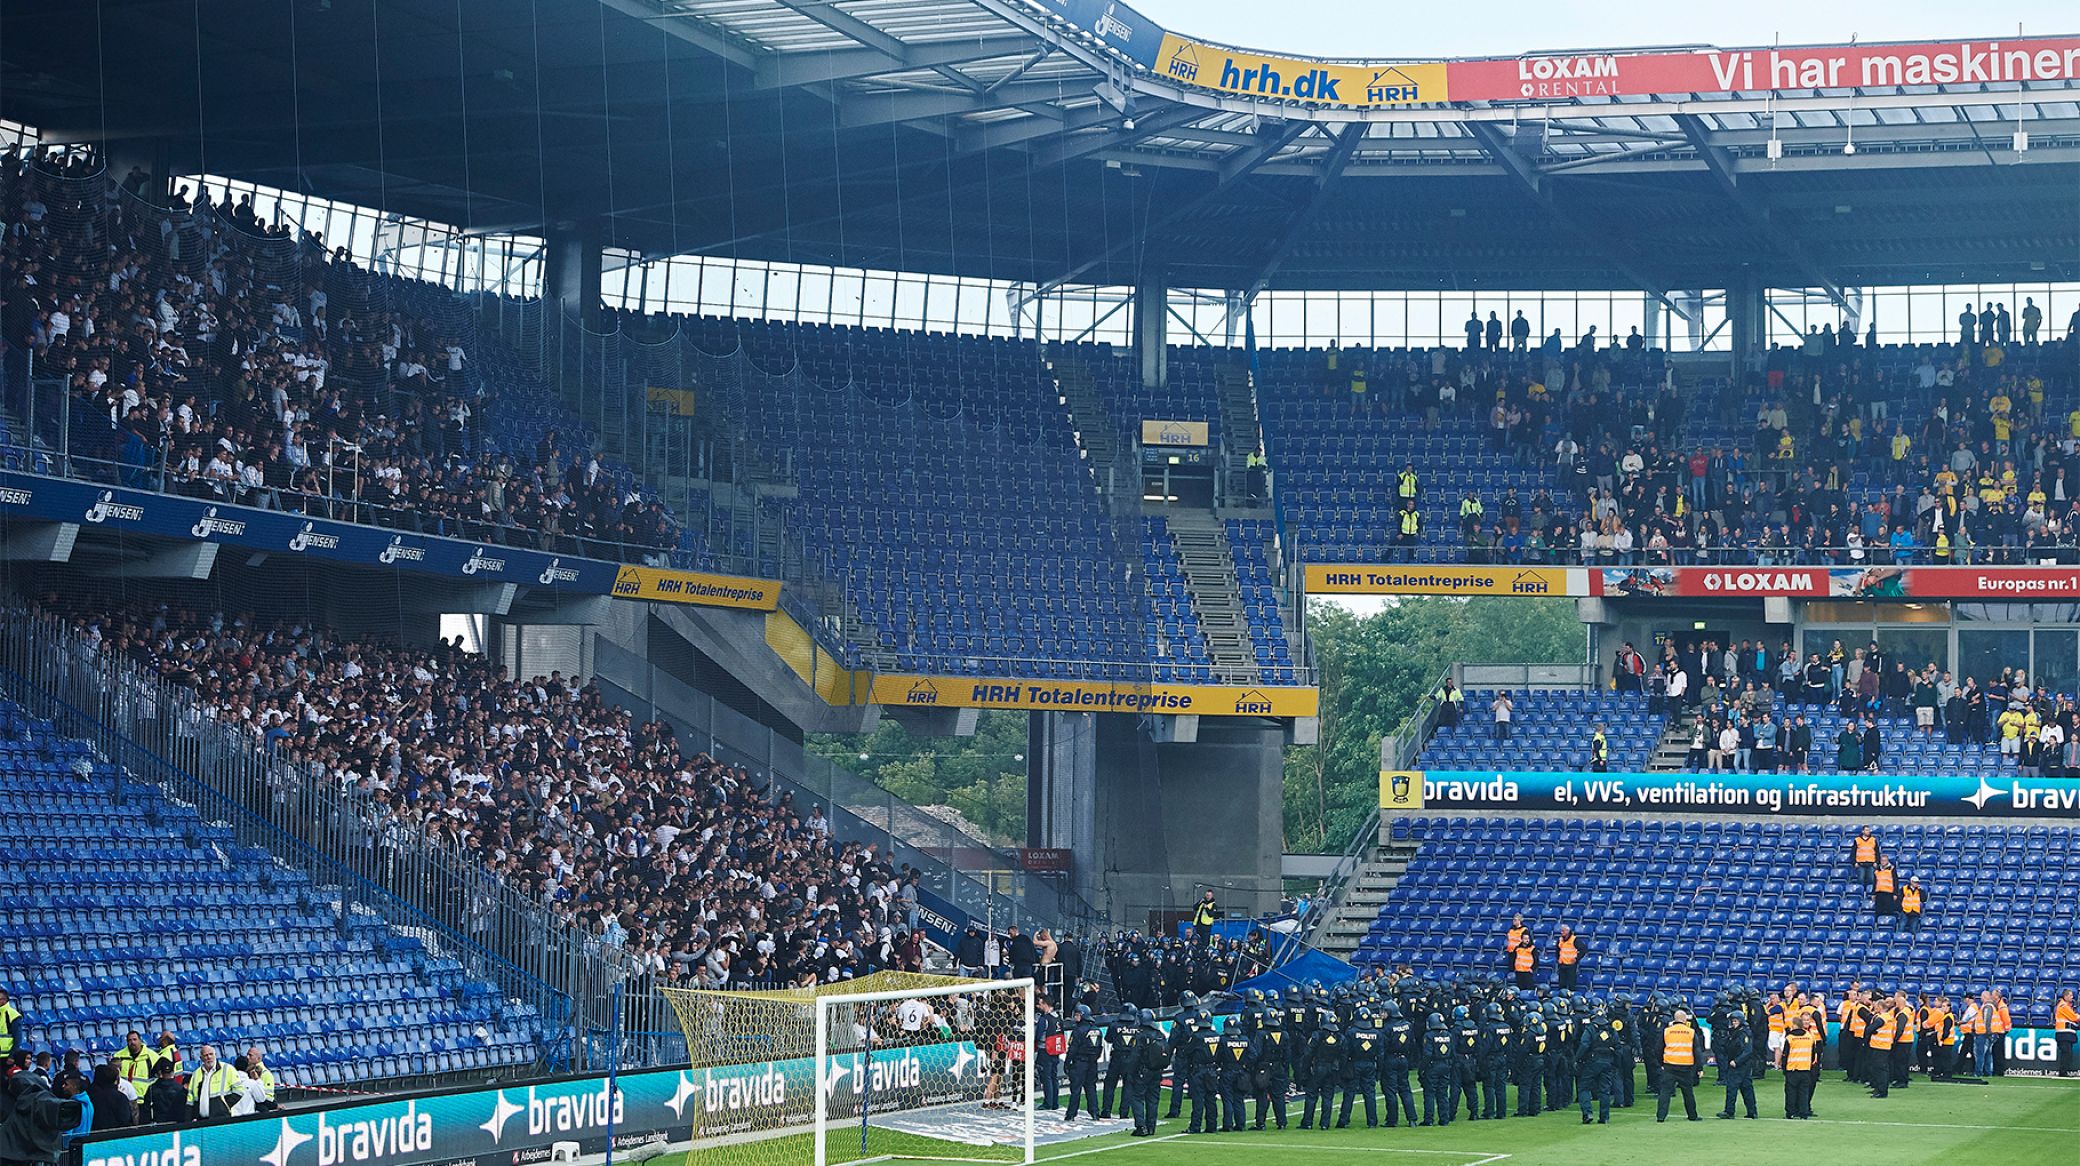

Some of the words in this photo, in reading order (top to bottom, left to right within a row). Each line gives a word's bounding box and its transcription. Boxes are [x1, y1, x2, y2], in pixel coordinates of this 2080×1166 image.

[1168, 60, 1198, 81] HRH
[1519, 57, 1619, 80] LOXAM
[1709, 53, 1753, 91] Vi
[1772, 47, 1846, 89] har
[1220, 58, 1342, 101] hrh.dk
[1539, 80, 1620, 96] RENTAL
[1367, 87, 1418, 102] HRH
[1160, 433, 1191, 444] HRH
[1189, 454, 1200, 463] 16
[614, 583, 640, 595] HRH
[657, 579, 683, 593] HRH
[685, 582, 764, 601] Totalentreprise
[1326, 573, 1362, 586] HRH
[1367, 573, 1494, 589] Totalentreprise
[1513, 583, 1548, 593] HRH
[1725, 574, 1814, 591] LOXAM
[1977, 576, 2045, 593] Europas
[906, 691, 937, 703] HRH
[972, 685, 1020, 702] HRH
[1028, 687, 1192, 711] Totalentreprise
[1235, 702, 1272, 714] HRH
[1554, 780, 1578, 806] el,
[1584, 781, 1631, 806] VVS,
[1636, 782, 1749, 805] ventilation
[1756, 787, 1781, 811] og
[1789, 783, 1932, 808] infrastruktur
[2013, 780, 2080, 809] brav
[705, 1062, 784, 1113] bravida
[528, 1077, 623, 1135] bravida
[318, 1099, 432, 1166] bravida
